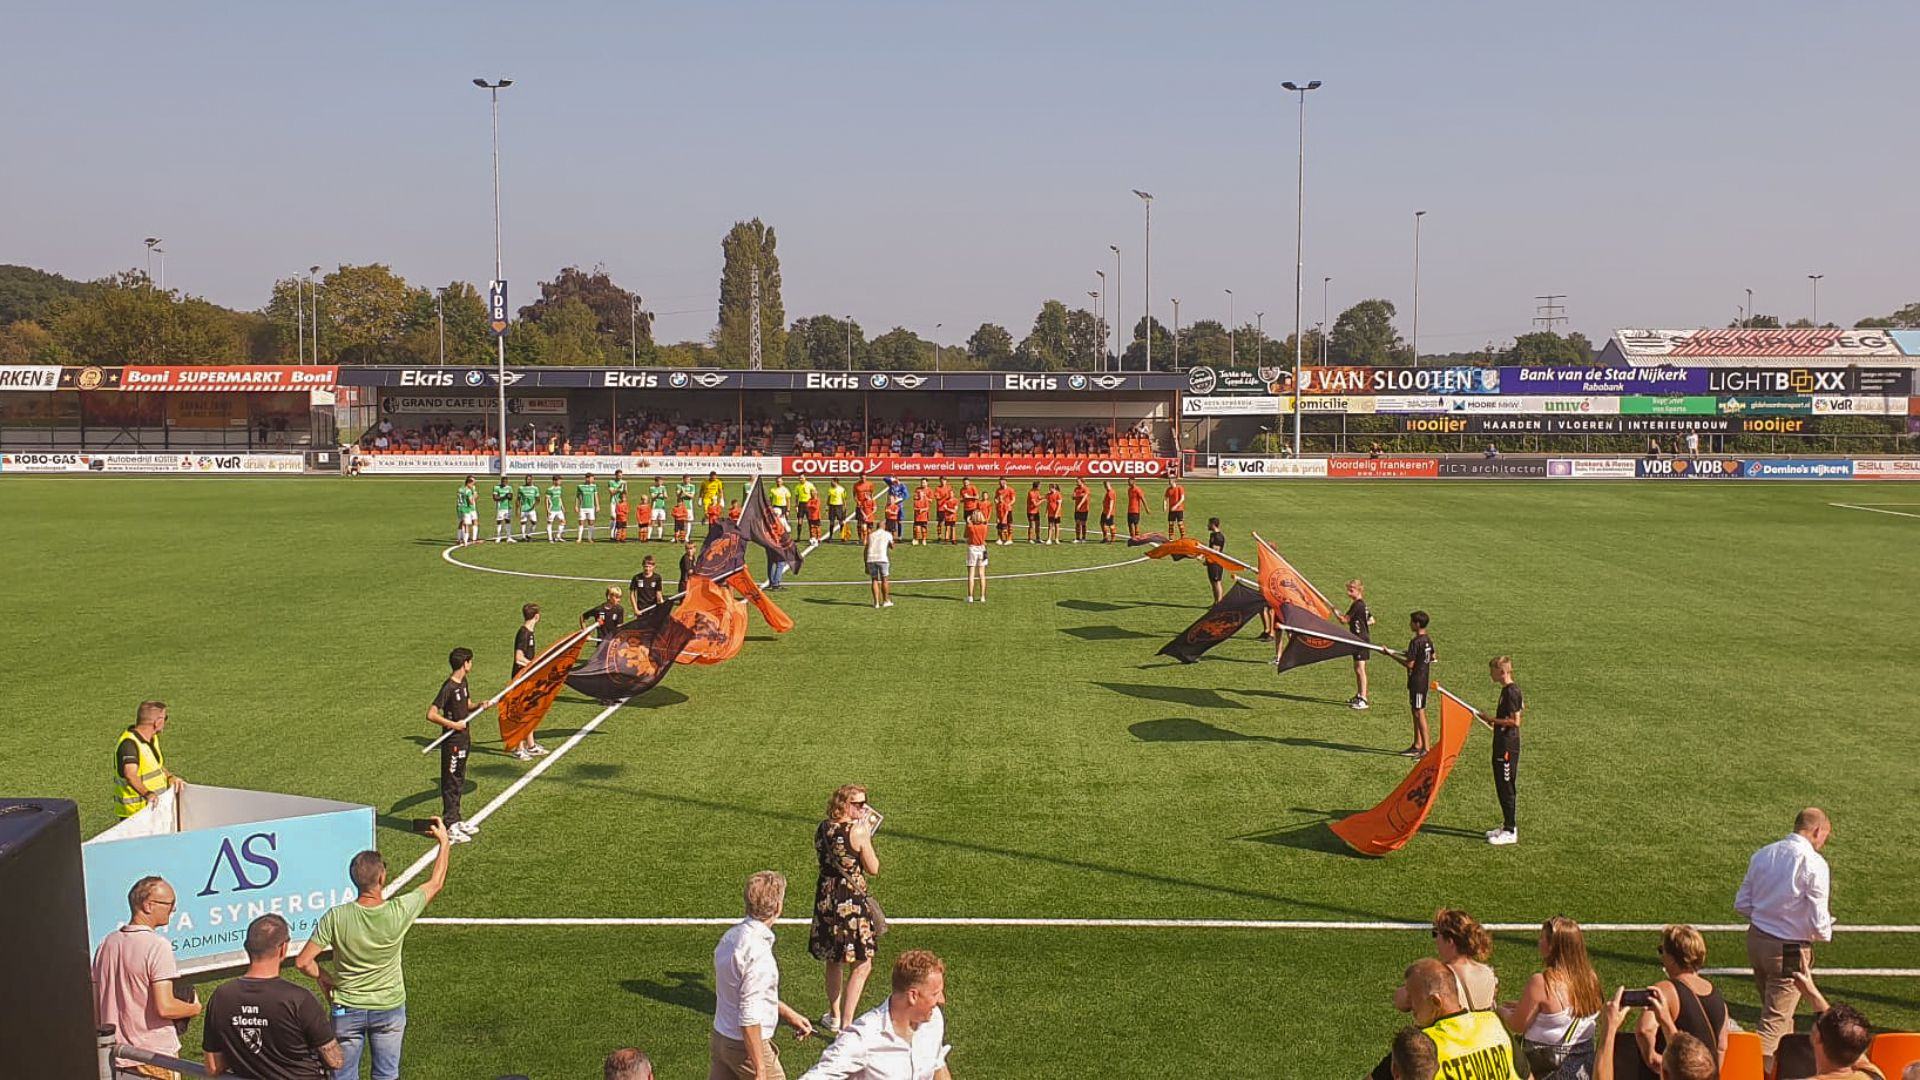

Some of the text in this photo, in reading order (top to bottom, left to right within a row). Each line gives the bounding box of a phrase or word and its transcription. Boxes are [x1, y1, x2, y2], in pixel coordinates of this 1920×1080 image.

[494, 282, 503, 319] VDB
[128, 370, 333, 383] Boni SUPERMARKT Boni
[400, 370, 454, 386] Ekris
[604, 371, 658, 388] Ekris
[807, 373, 859, 389] Ekris
[1005, 374, 1057, 390] Ekris
[1319, 370, 1472, 389] VAN SLOOTEN
[1520, 369, 1687, 383] Bank van de Stad Nijkerk
[1582, 382, 1624, 391] Rabobank
[401, 398, 442, 408] GRAND
[1545, 398, 1590, 412] univé
[1830, 400, 1853, 410] VdR
[1483, 420, 1728, 430] HAARDEN VLOEREN INTERIEURBOUW
[14, 455, 77, 464] ROBO-GAS
[215, 457, 241, 469] VdR
[509, 460, 535, 469] Albert
[792, 459, 864, 473] COVEBO
[891, 460, 921, 471] Ieders
[923, 460, 955, 471] wereld
[957, 462, 975, 471] van
[1330, 460, 1435, 471] Voordelig frankeren?
[1088, 460, 1160, 474] COVEBO
[1239, 460, 1265, 473] VdR
[1302, 463, 1326, 475] print
[1471, 464, 1545, 473] architecten
[1643, 460, 1672, 473] VDB
[1693, 460, 1723, 473] VDB
[1763, 464, 1850, 476] Domino's Nijkerk
[210, 887, 354, 925] SYNERGIA
[299, 921, 307, 931] &
[241, 1004, 259, 1014] van
[232, 1015, 269, 1026] Slooten
[1441, 1044, 1511, 1080] STEWARD
